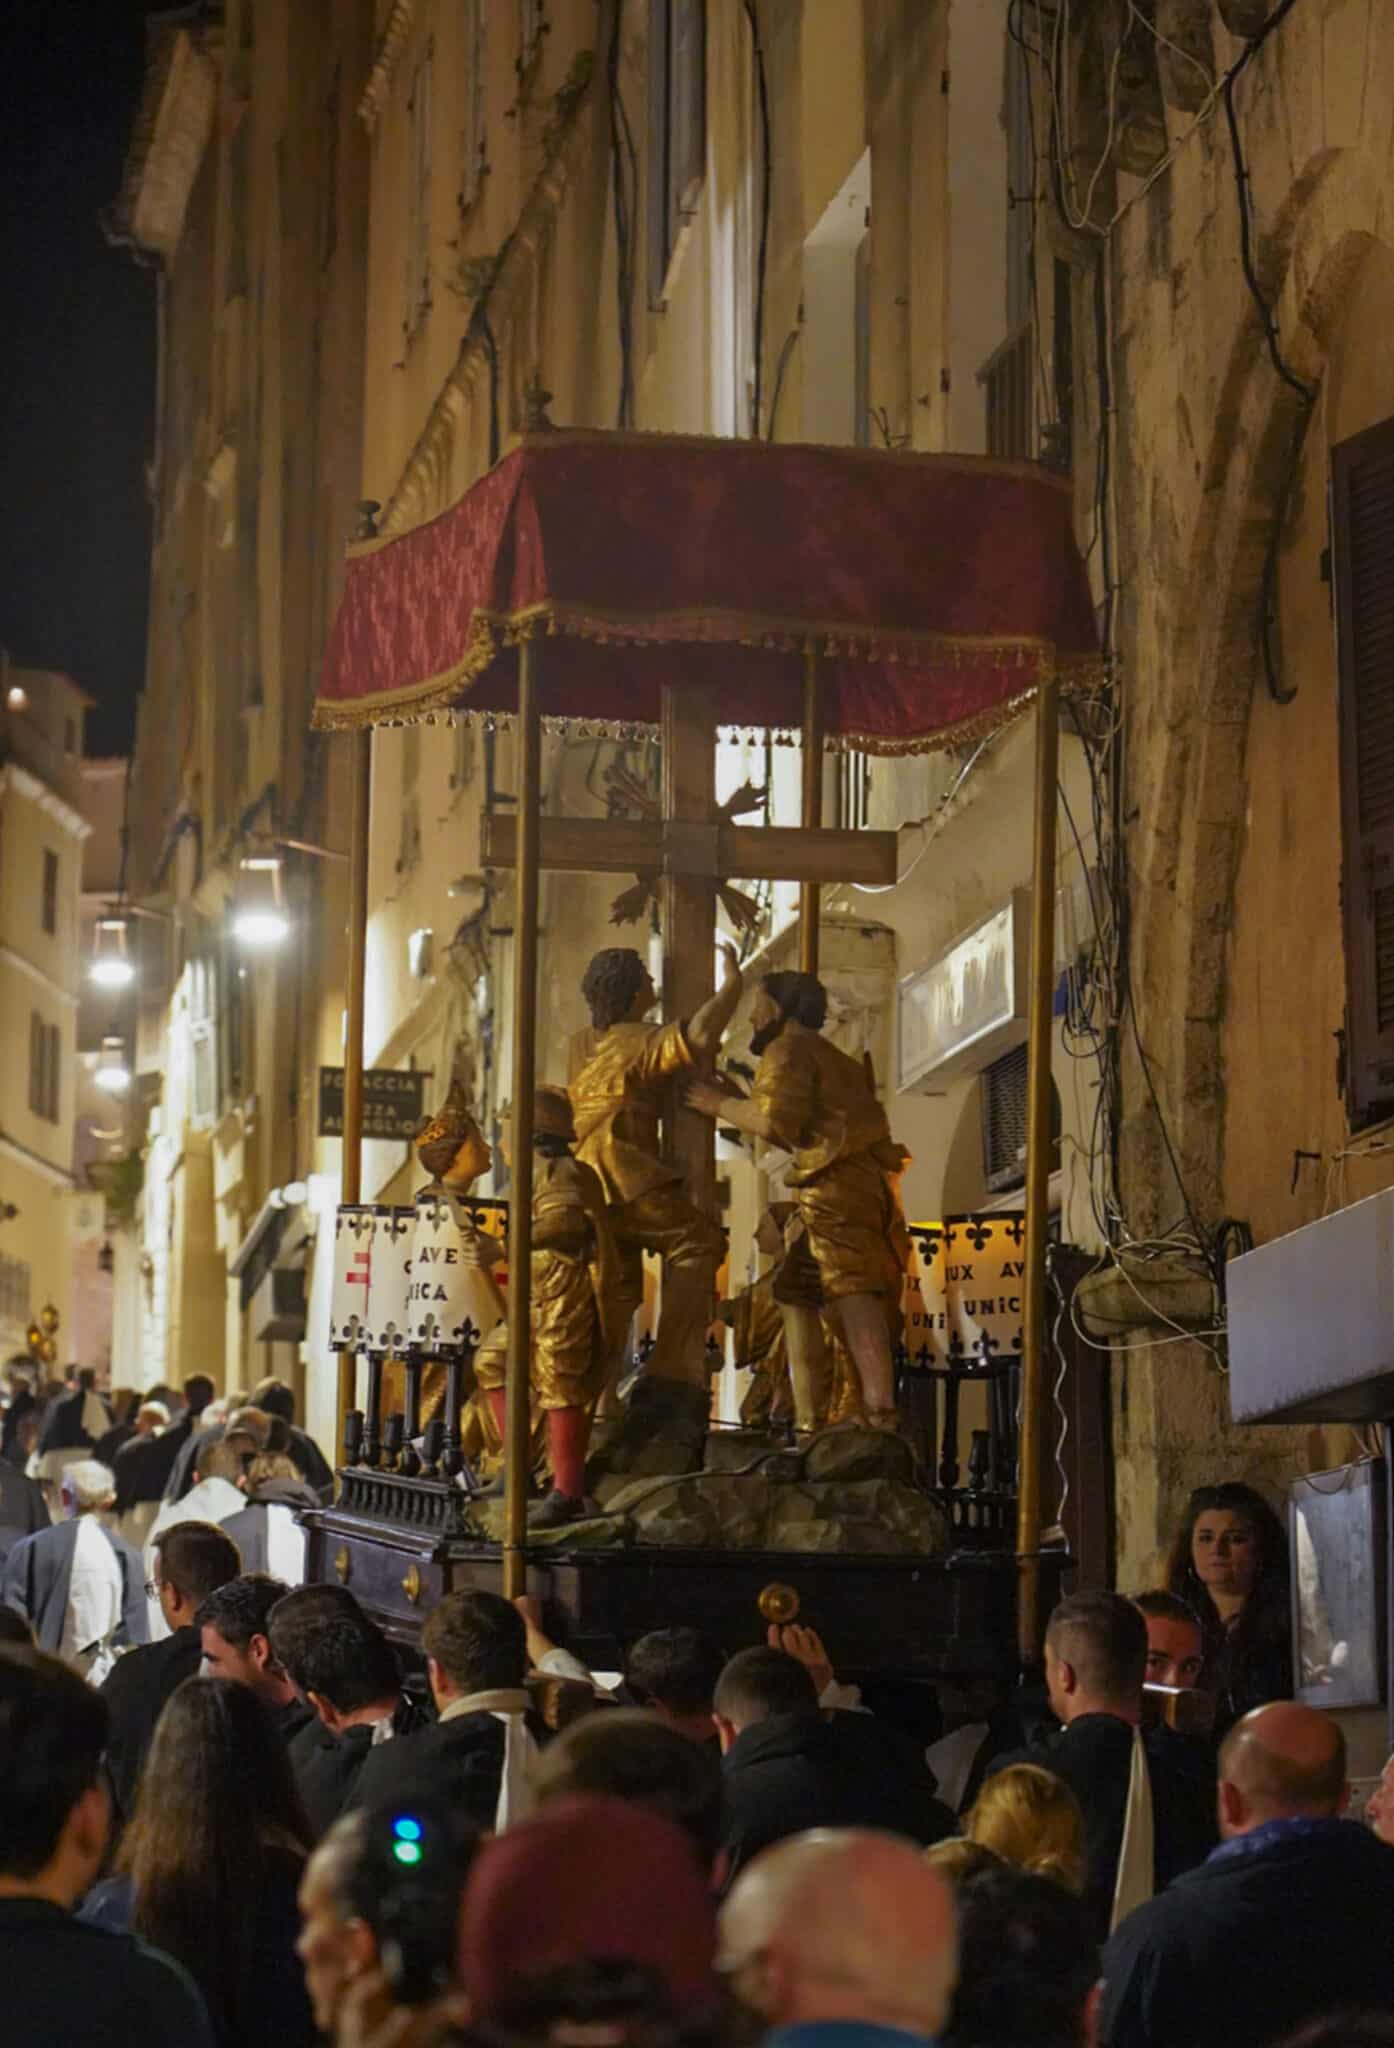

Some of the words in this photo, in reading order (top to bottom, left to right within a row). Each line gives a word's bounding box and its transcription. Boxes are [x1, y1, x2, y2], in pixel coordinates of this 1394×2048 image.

[323, 1073, 416, 1092] FOACCIA
[362, 1120, 417, 1134] AGLIO
[419, 1247, 458, 1264] AVE
